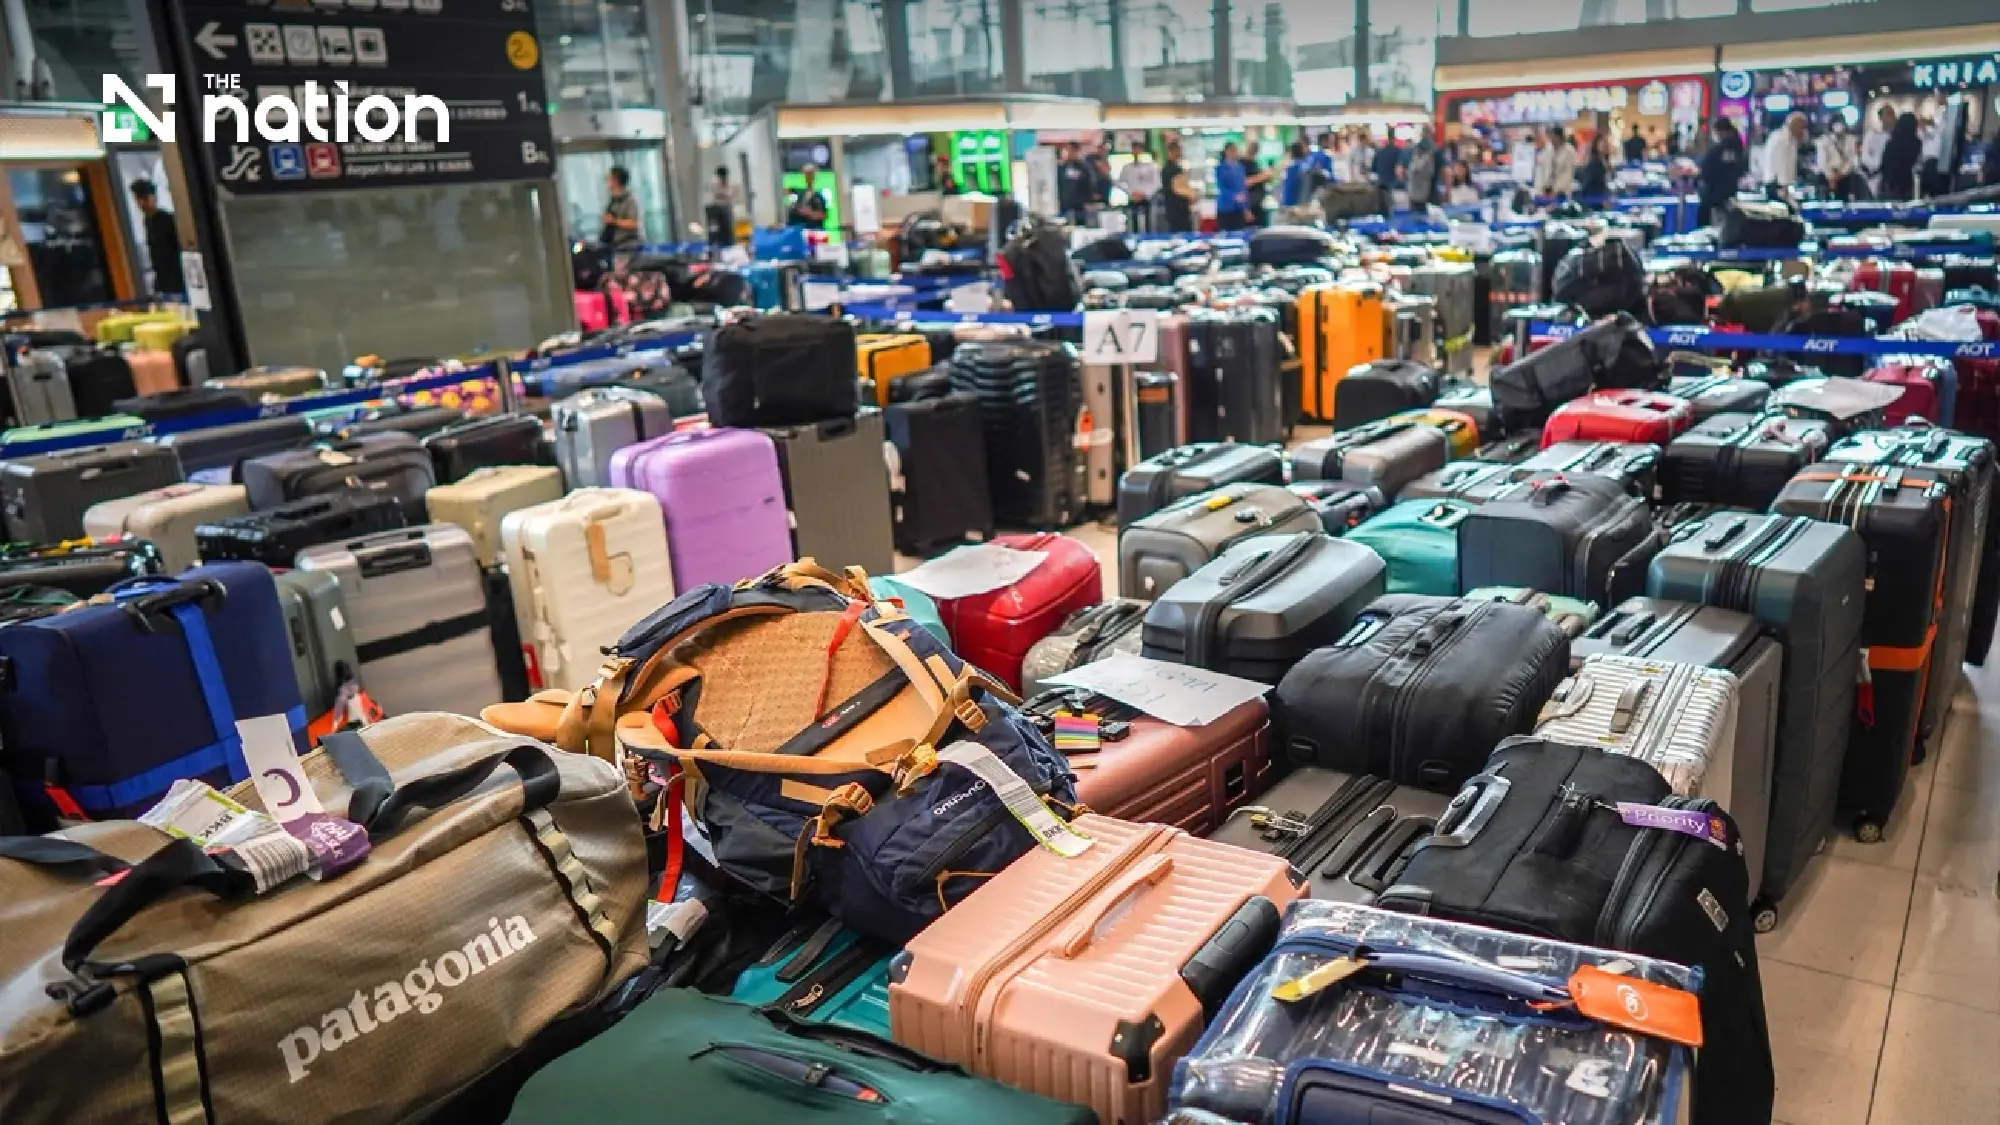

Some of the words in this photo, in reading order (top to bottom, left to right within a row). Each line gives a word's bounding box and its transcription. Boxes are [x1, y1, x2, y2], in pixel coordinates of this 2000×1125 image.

[1668, 333, 1698, 346] AOT
[1803, 339, 1838, 352] AOT
[1955, 342, 1995, 356] AOT
[1634, 808, 1706, 834] Priority
[276, 915, 538, 1084] patagonia
